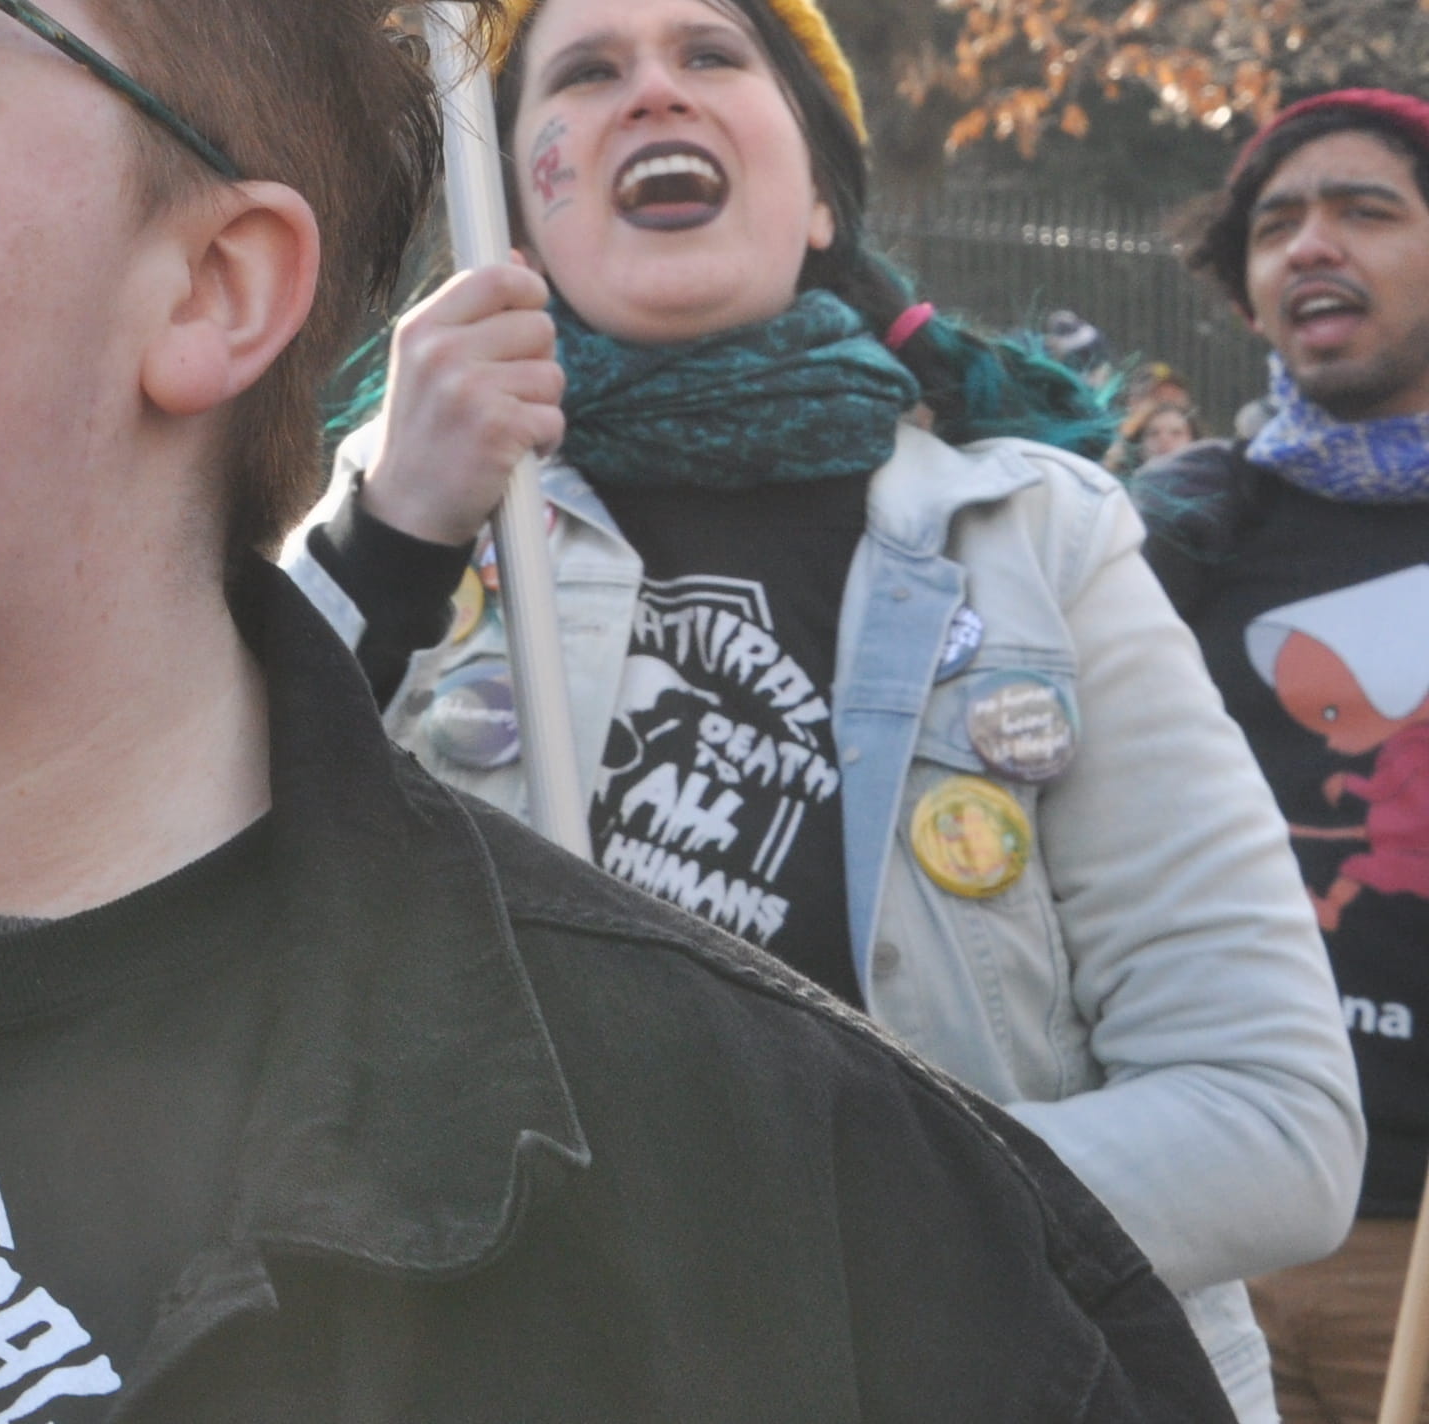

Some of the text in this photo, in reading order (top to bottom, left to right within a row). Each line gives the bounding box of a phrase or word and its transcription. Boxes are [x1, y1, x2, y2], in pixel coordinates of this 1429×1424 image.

[632, 598, 831, 749] ATURAL
[698, 710, 839, 804] DEATH
[602, 831, 790, 946] HUMANS
